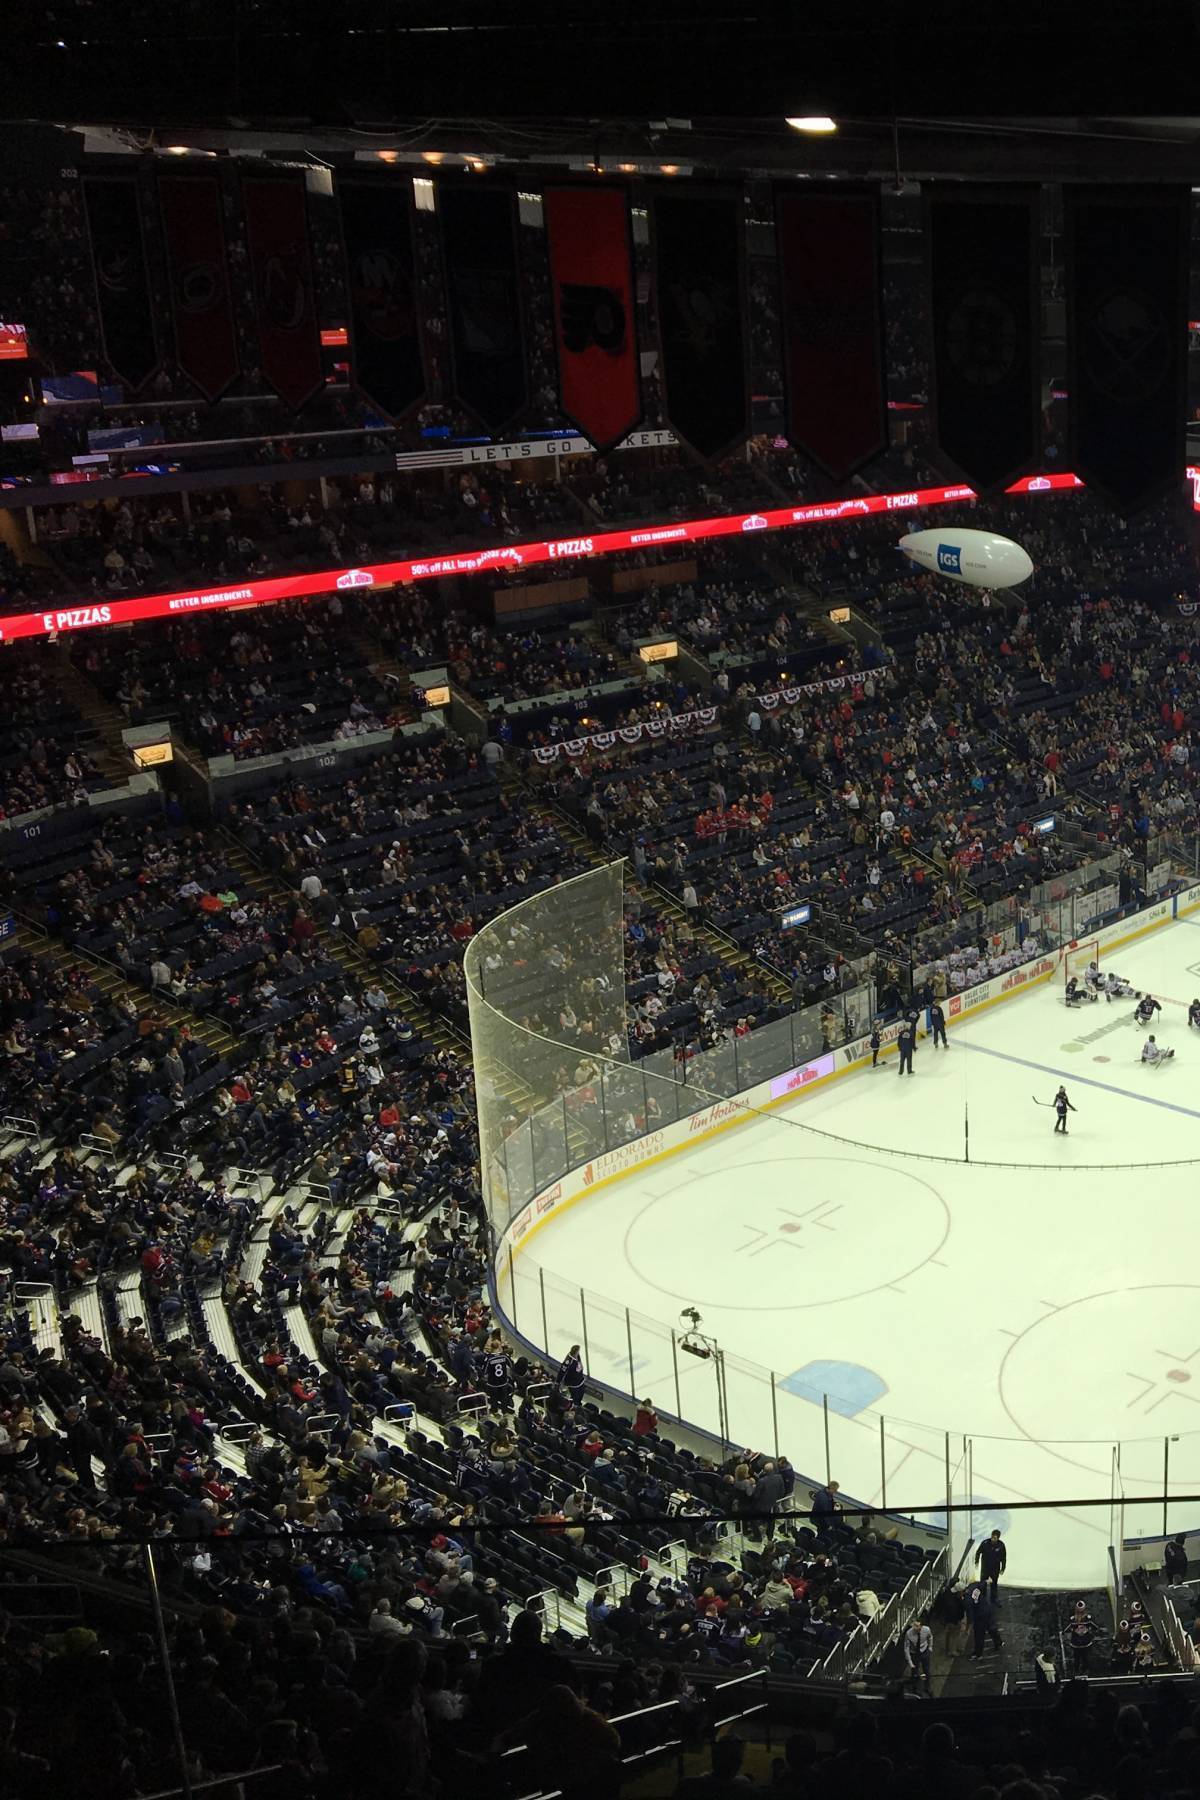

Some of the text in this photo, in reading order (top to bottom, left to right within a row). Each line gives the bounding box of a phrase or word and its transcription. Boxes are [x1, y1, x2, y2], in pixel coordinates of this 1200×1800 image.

[470, 444, 531, 462] LET'S
[547, 441, 572, 454] GO
[893, 493, 919, 508] PIZZAS
[557, 538, 593, 556] PIZZAS
[411, 563, 429, 576] 50%
[429, 561, 441, 573] off
[441, 560, 457, 572] ALL
[457, 558, 477, 570] large
[938, 551, 960, 567] IGS
[169, 588, 254, 610] BETTER INGREDIENTS.
[57, 605, 111, 630] PIZZAS
[776, 656, 787, 666] 104
[574, 700, 588, 711] 103
[319, 755, 336, 768] 102
[23, 825, 41, 839] 101
[979, 984, 990, 995] CITY
[964, 991, 989, 1009] FURNITURE
[688, 1112, 709, 1132] Tim
[709, 1097, 750, 1123] Hortons
[596, 1131, 664, 1170] ELDORADO
[597, 1142, 665, 1180] SCIOTO DOWNS
[493, 1363, 504, 1378] 8
